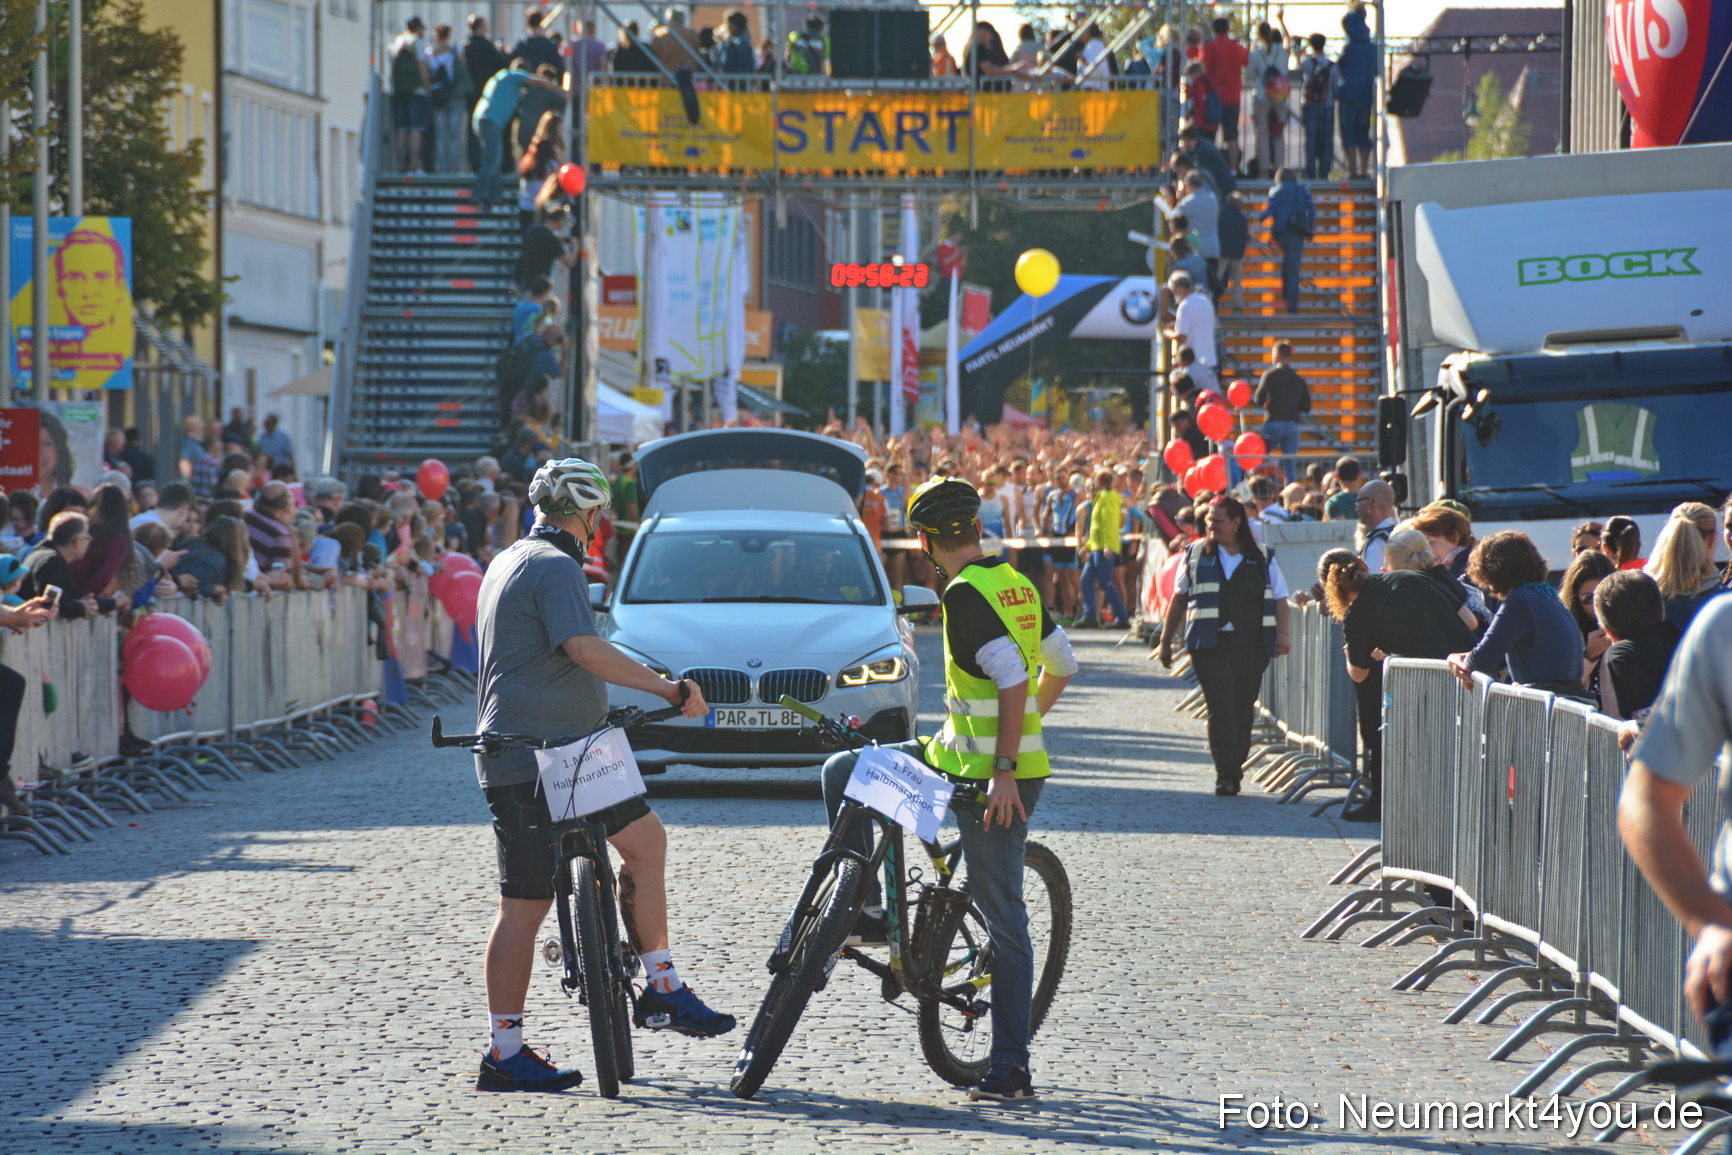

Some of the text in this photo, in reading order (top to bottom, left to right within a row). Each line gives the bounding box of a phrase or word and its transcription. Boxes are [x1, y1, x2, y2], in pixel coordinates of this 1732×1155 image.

[777, 110, 971, 154] START
[1518, 247, 1702, 286] BOCK
[965, 315, 1055, 374] PARTL NEUMARKT
[716, 711, 746, 725] PAR
[758, 711, 777, 725] TL
[552, 760, 625, 791] Halbmarathon
[866, 768, 934, 813] Halbmarathon
